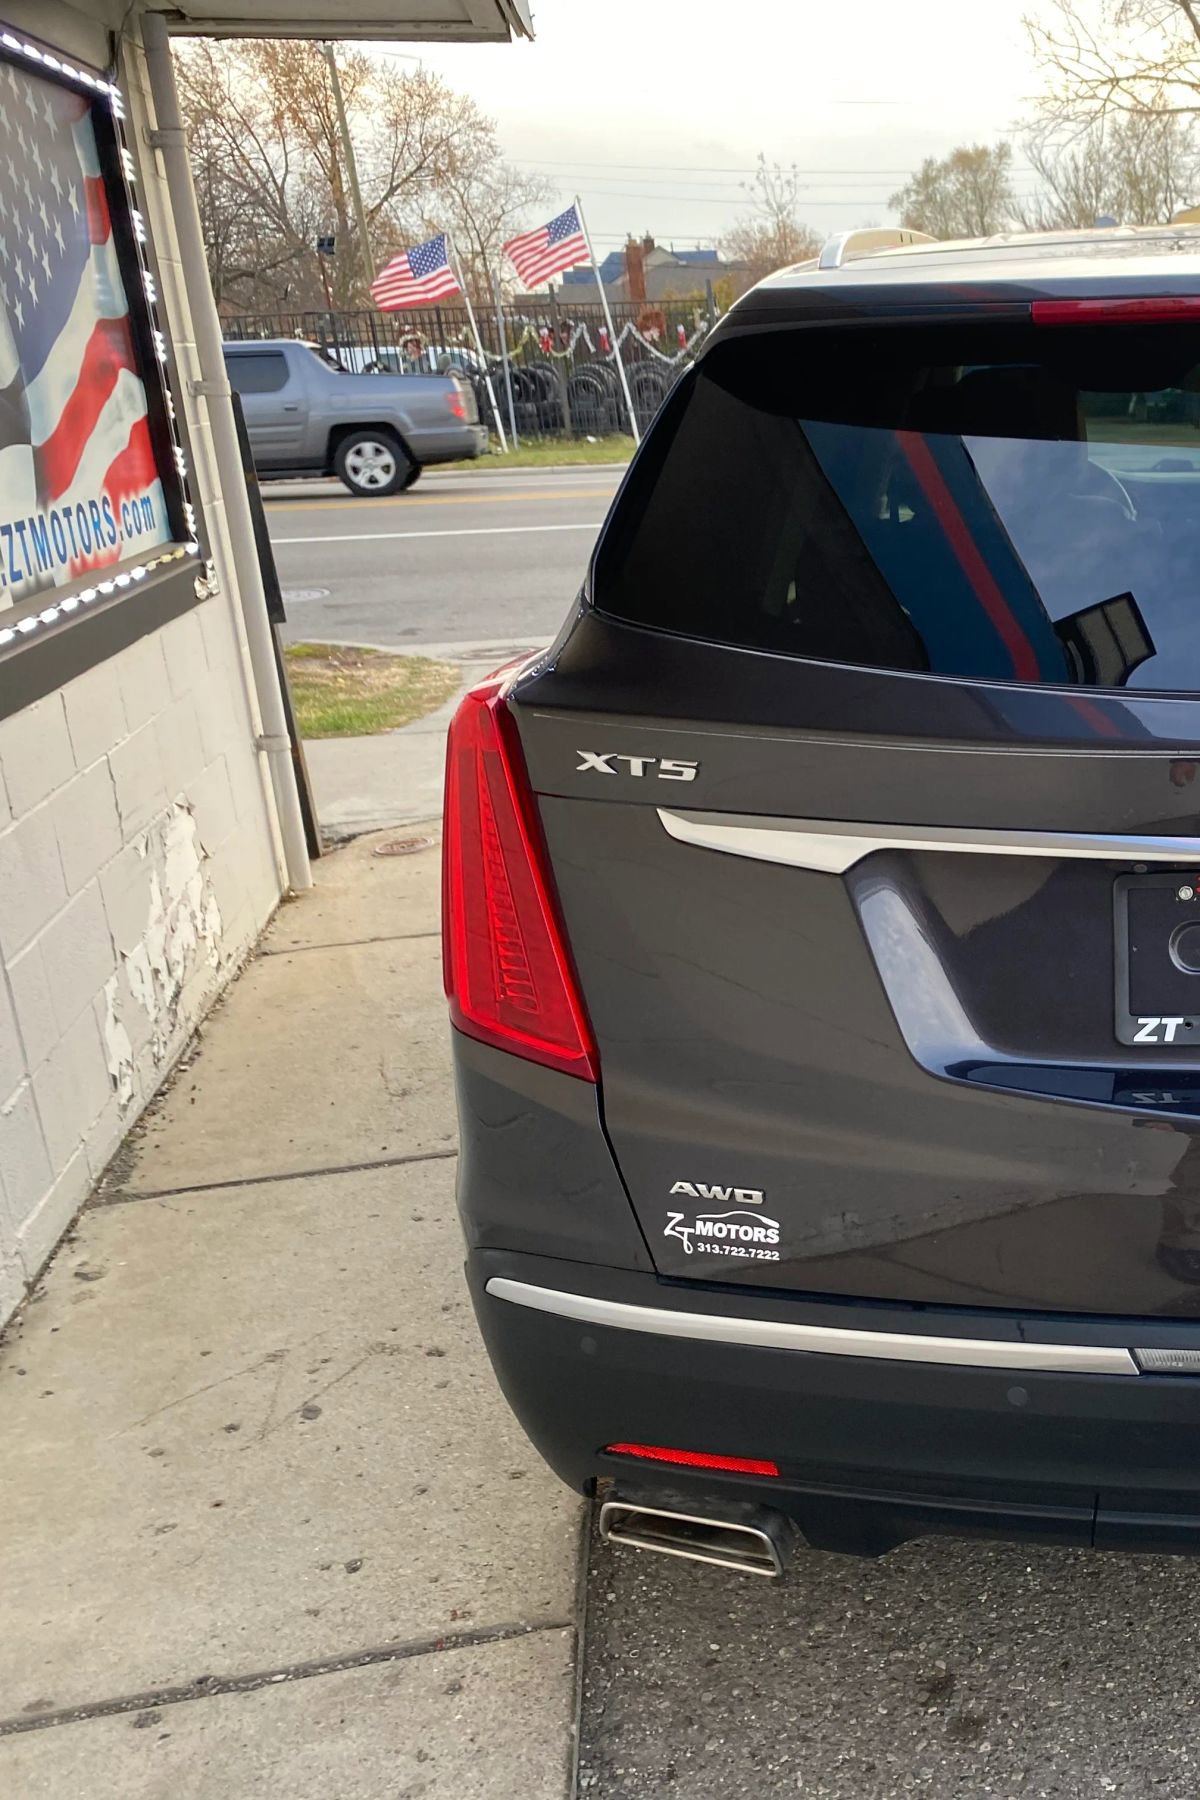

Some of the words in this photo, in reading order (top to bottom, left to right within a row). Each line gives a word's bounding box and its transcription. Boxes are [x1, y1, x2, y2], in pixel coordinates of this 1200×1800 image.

[576, 750, 698, 781] XT5
[1133, 1017, 1184, 1042] ZT
[669, 1181, 764, 1205] AWD
[695, 1220, 780, 1244] MOTORS
[697, 1243, 780, 1261] 313.722.7222
